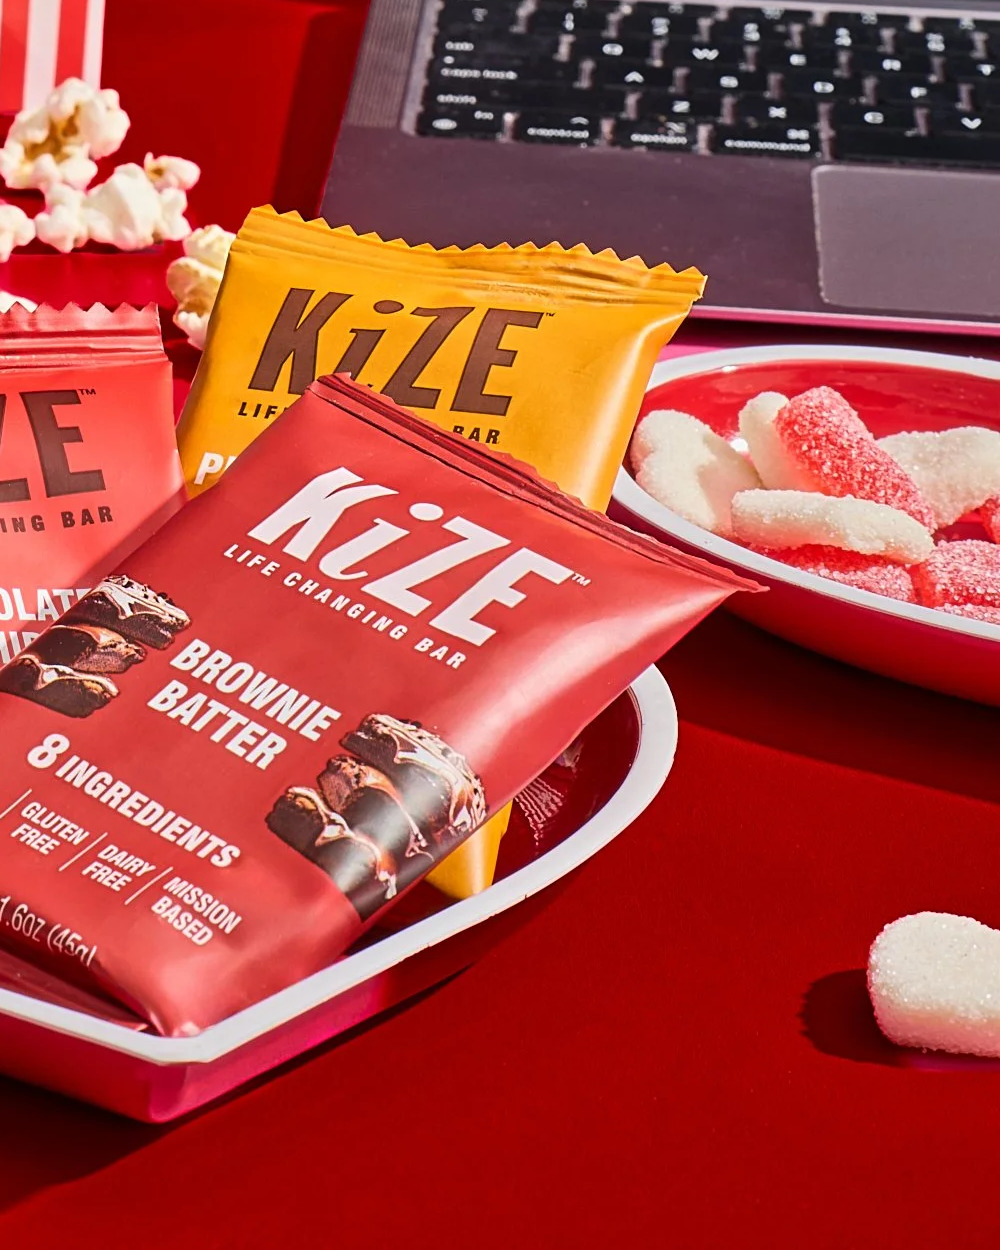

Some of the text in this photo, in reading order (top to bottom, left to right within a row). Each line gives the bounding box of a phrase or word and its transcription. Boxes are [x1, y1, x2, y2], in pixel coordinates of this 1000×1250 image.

[247, 287, 545, 417] KiZE
[238, 402, 288, 419] LIF
[62, 506, 114, 530] BAR
[246, 466, 574, 647] KiZE
[223, 543, 467, 670] LIFE CHANGING BAR
[169, 638, 341, 743] BROWNIE
[146, 679, 289, 771] BATTER
[20, 801, 90, 846] GLUTEN
[27, 733, 241, 868] 8 INGREDIENTS
[11, 824, 60, 856] FREE
[97, 844, 157, 878] DAIRY
[82, 862, 133, 892] FREE
[150, 897, 214, 947] BASED
[162, 876, 242, 935] MISSION
